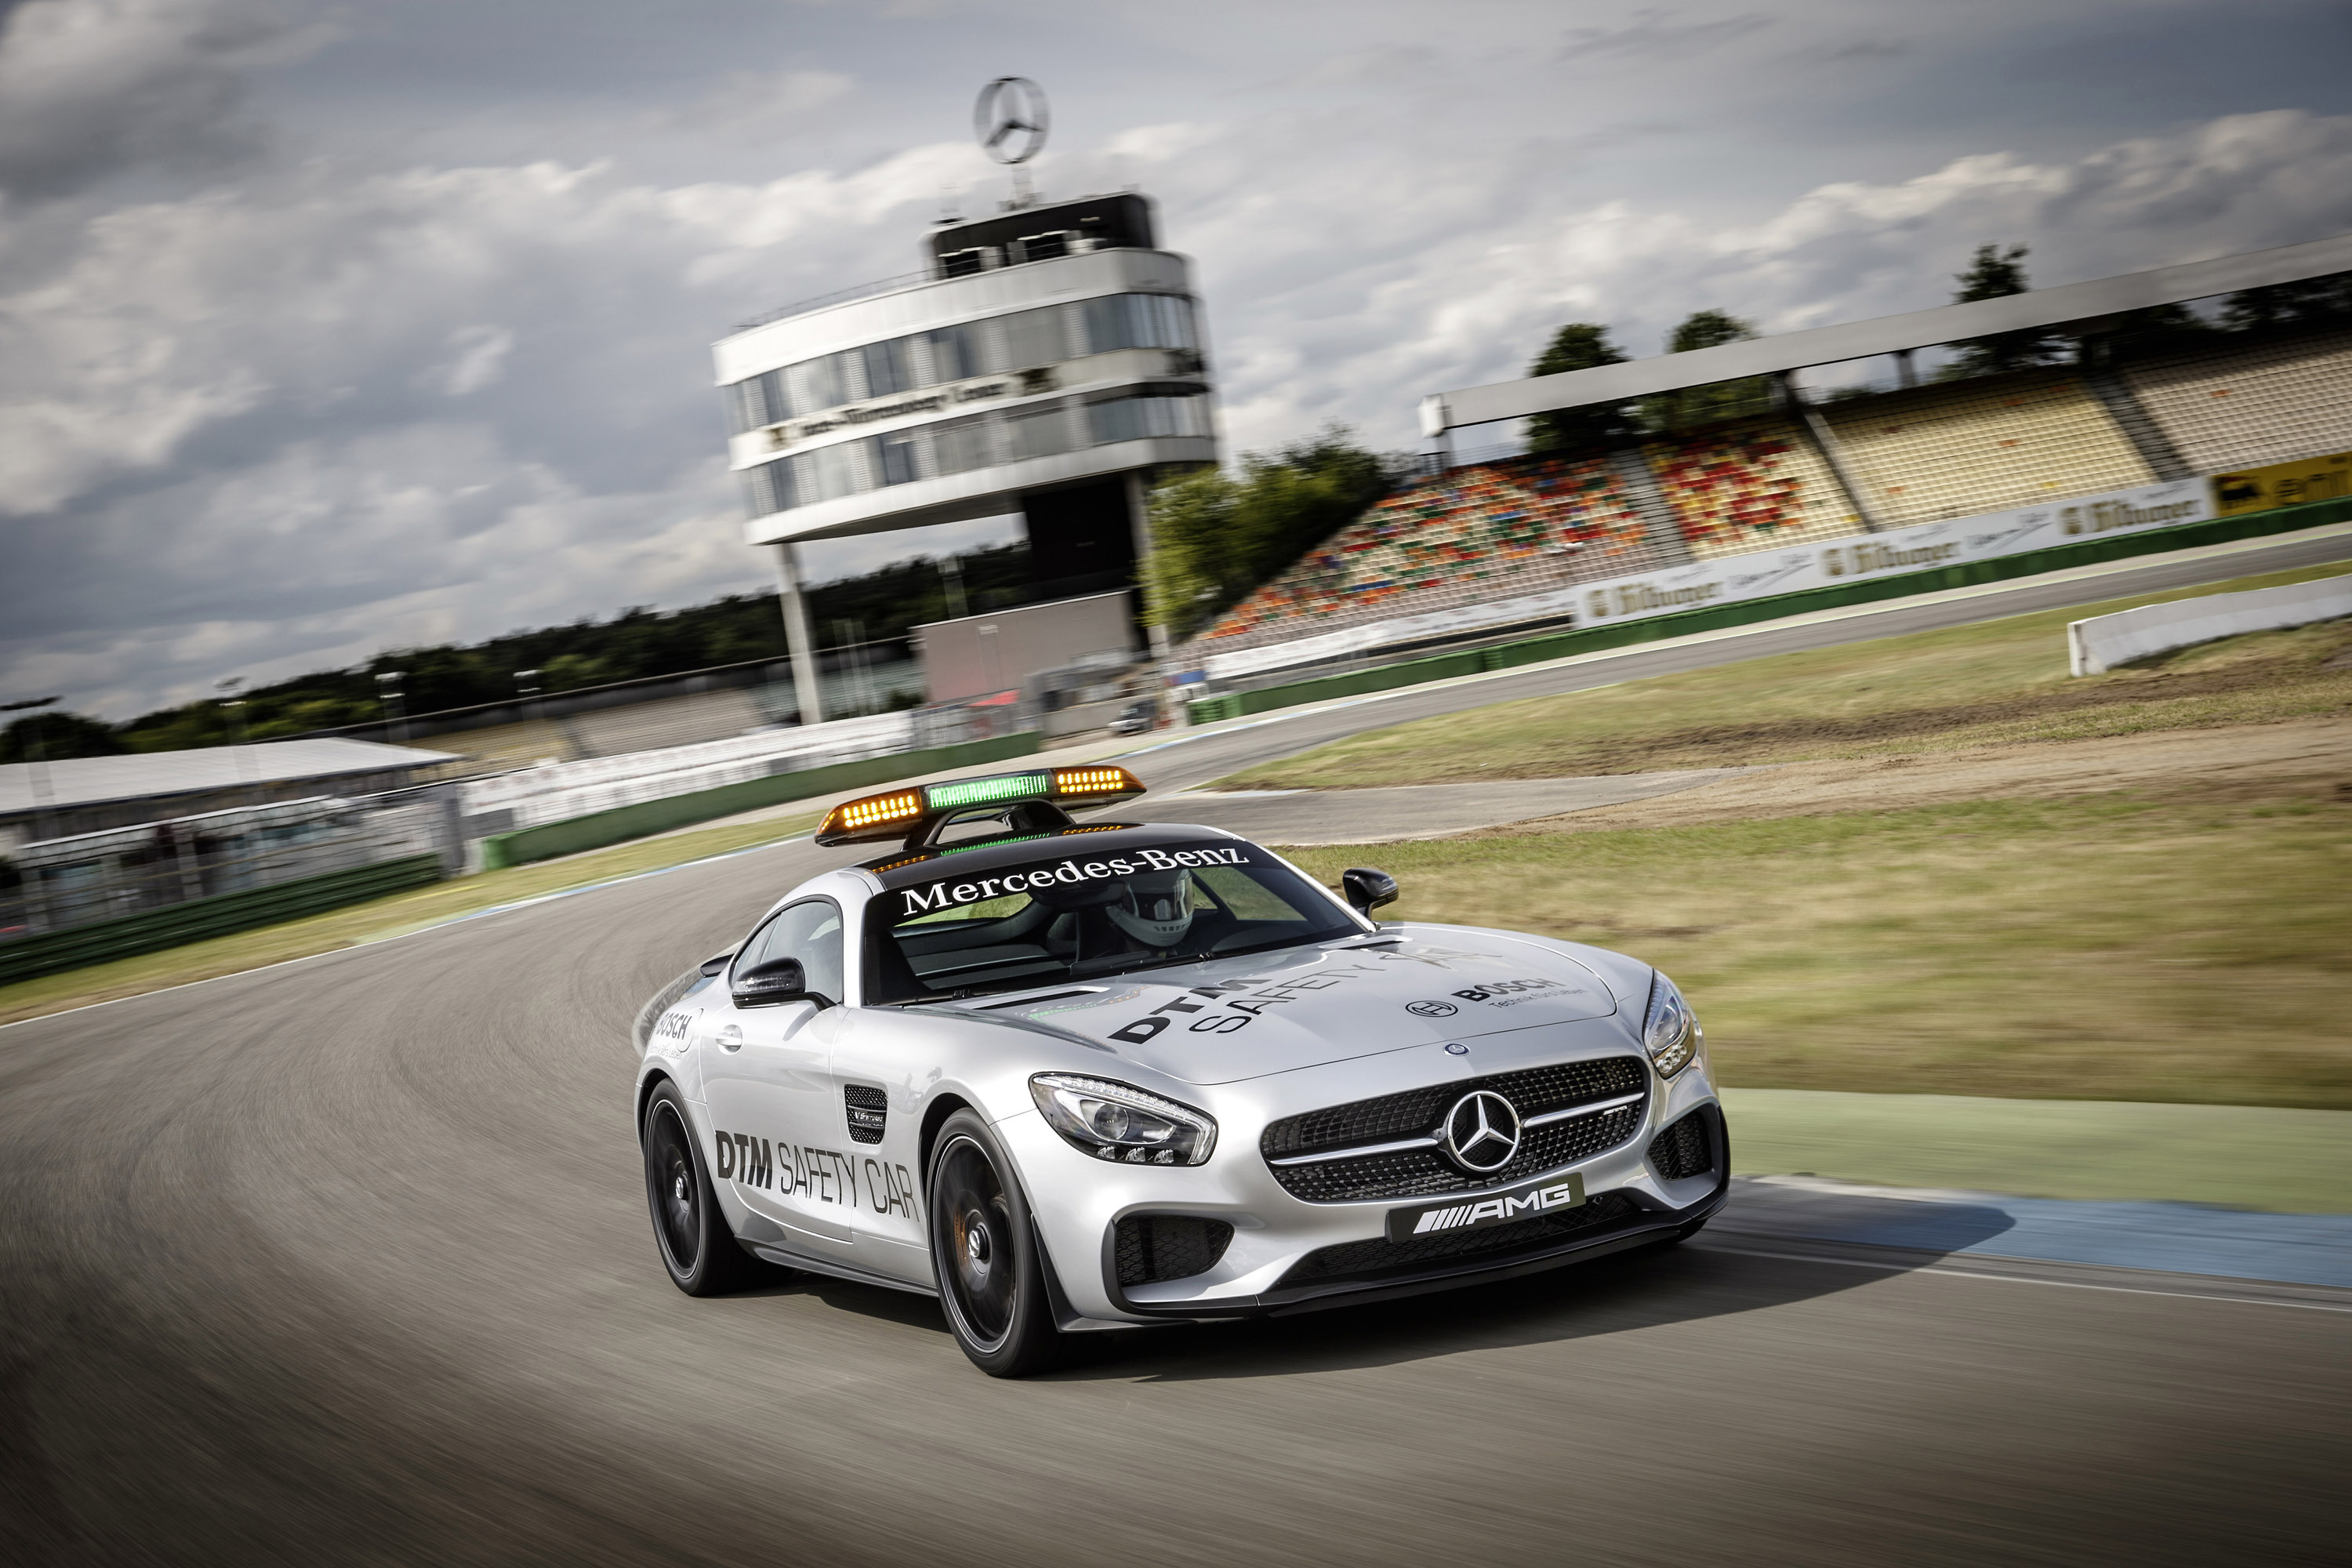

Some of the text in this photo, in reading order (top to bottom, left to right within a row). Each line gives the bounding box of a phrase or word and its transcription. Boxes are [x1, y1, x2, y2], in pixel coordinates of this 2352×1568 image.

[901, 848, 1250, 916] Mercedes-Benz
[1107, 964, 1386, 1044] DTM SAFETY
[1450, 978, 1566, 1002] BOSCH
[716, 1130, 920, 1222] DTM SAFETY CAR
[1465, 1183, 1570, 1225] AMG
